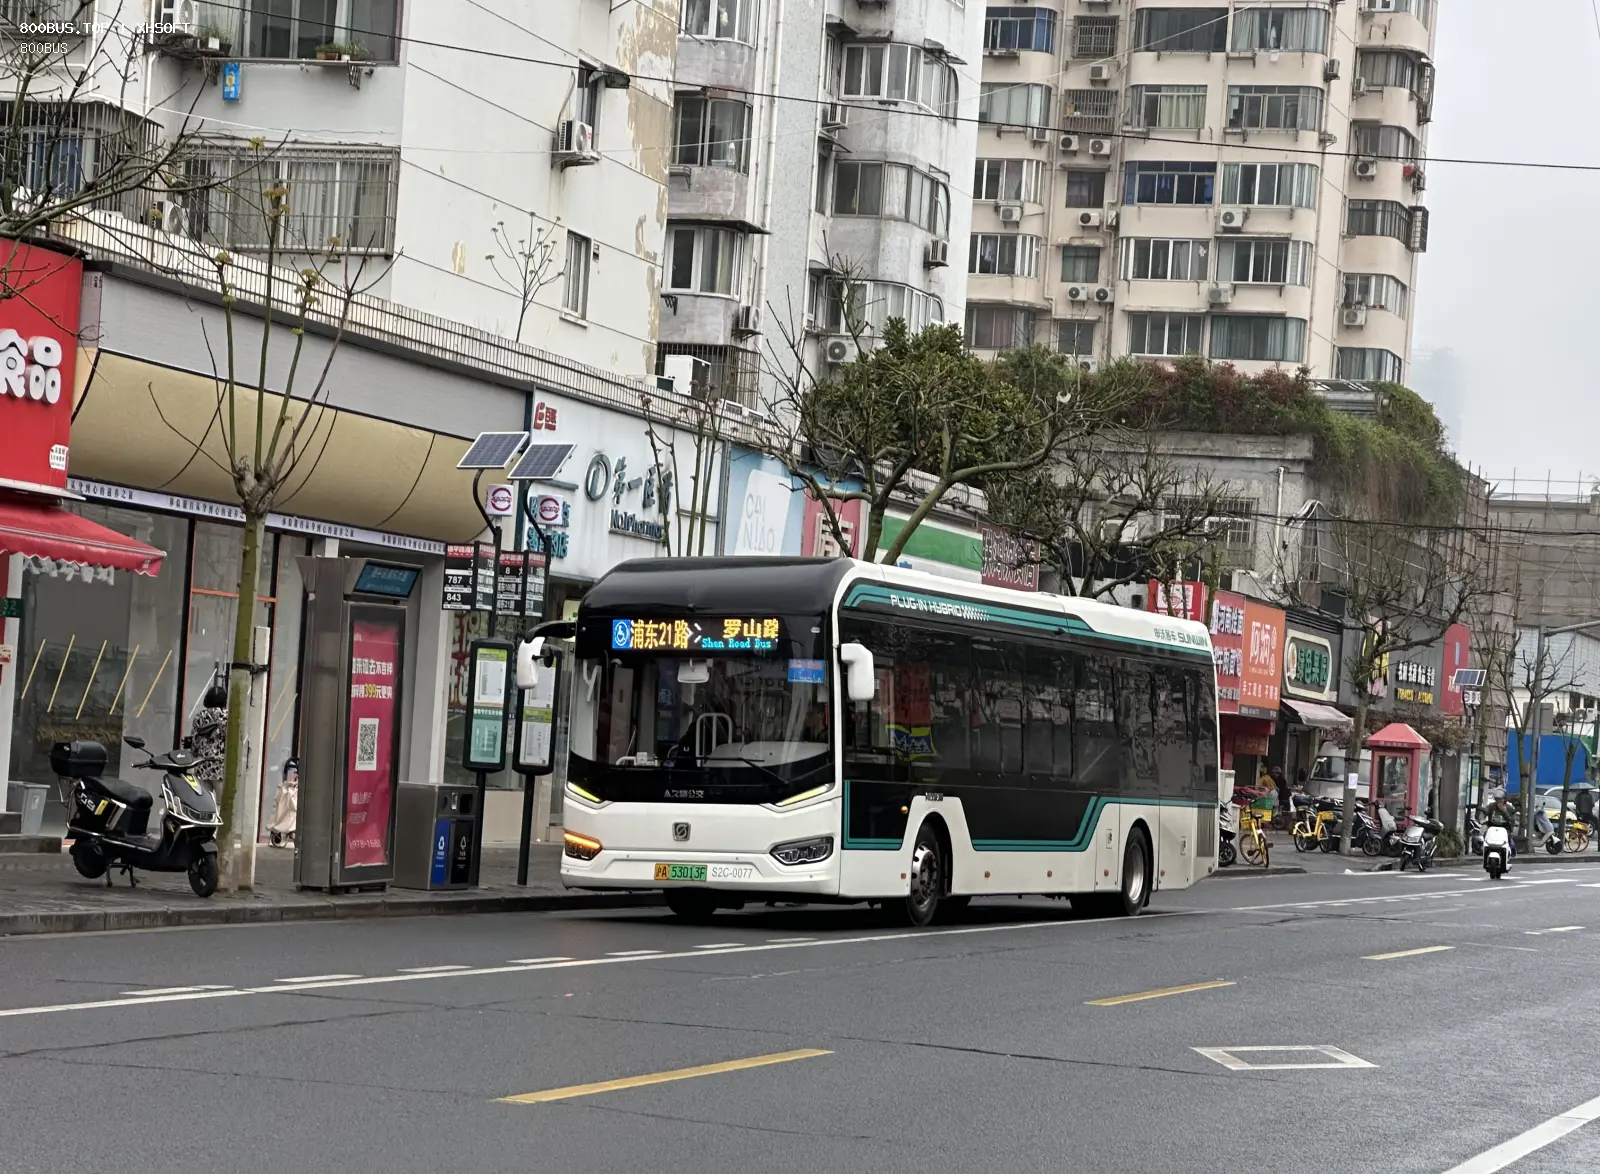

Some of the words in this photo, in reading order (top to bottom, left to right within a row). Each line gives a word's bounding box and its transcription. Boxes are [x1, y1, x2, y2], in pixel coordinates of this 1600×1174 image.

[448, 575, 462, 584] 787
[446, 593, 461, 602] 843
[890, 594, 928, 613] PLUG-IN
[929, 600, 963, 617] HYBRID
[630, 619, 688, 649] 浦东21路
[1177, 631, 1208, 648] SUNWIN
[728, 636, 751, 648] Road
[754, 637, 772, 649] Bus
[671, 865, 706, 879] 53013F
[711, 867, 753, 879] S2C-0077
